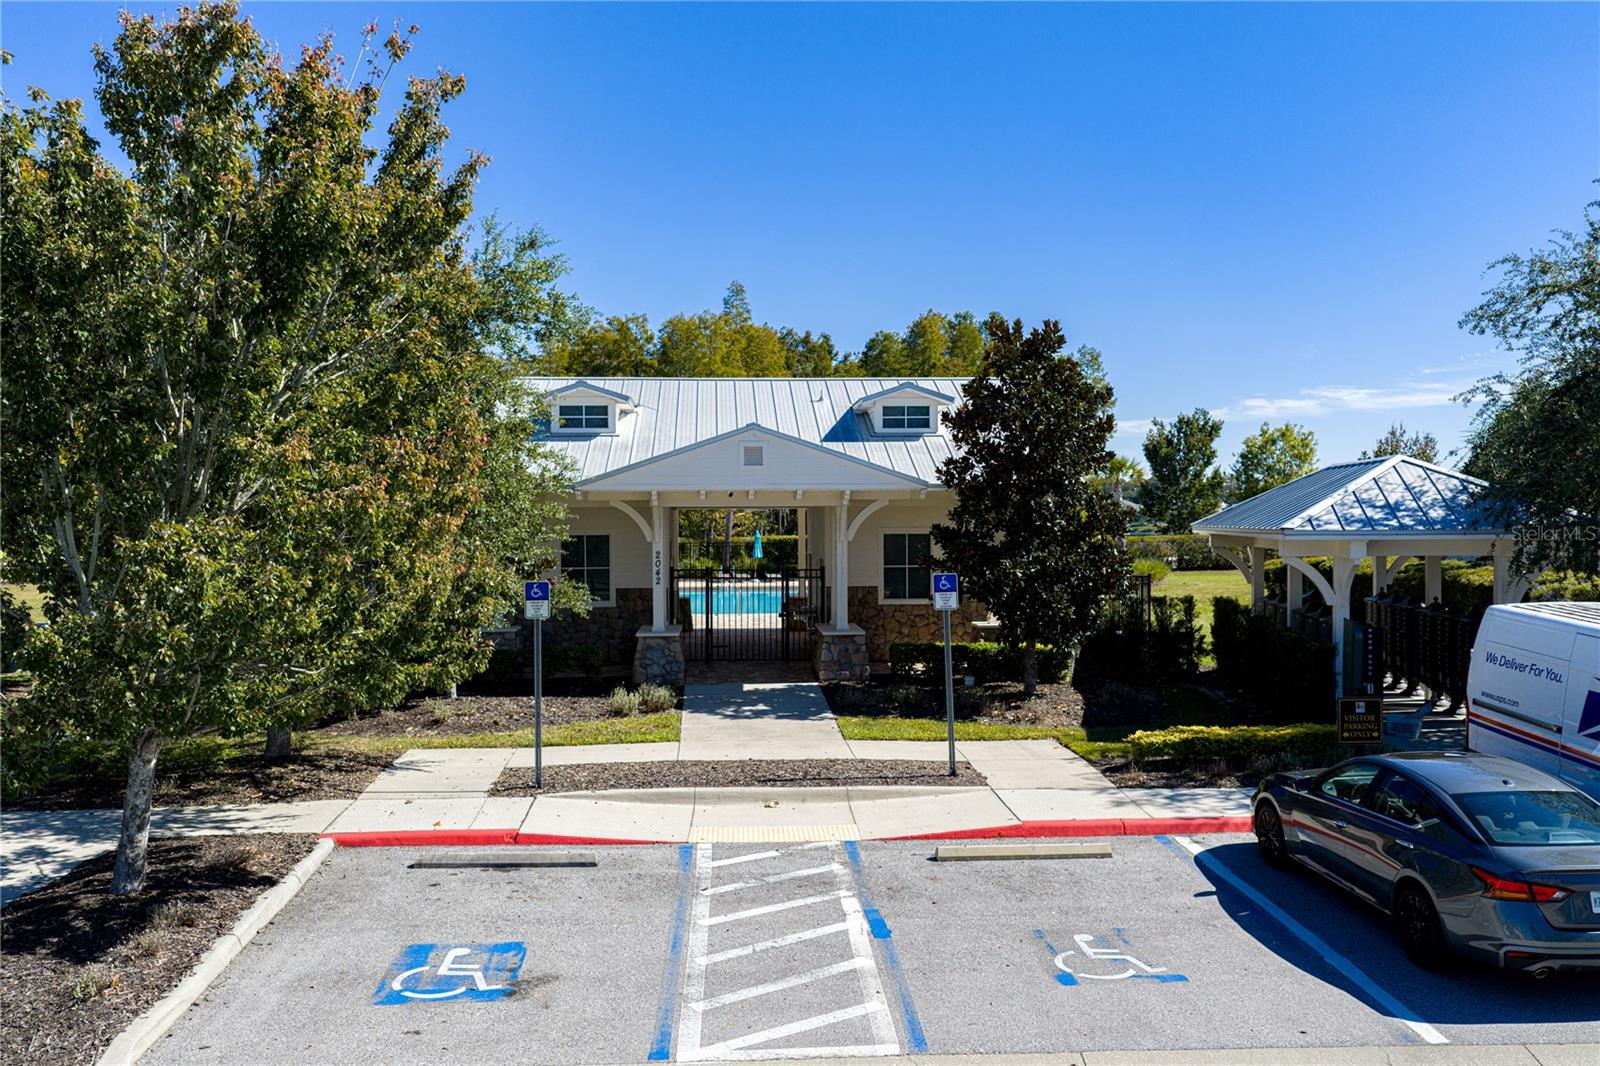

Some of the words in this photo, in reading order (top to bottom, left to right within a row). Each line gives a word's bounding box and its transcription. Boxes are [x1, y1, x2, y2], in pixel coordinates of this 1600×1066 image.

[1486, 651, 1498, 665] We
[1498, 655, 1529, 673] Deliver
[1528, 663, 1545, 677] For
[1545, 666, 1563, 684] You.
[1480, 690, 1520, 708] www.usps.com
[1343, 722, 1378, 730] PARKING
[1350, 730, 1371, 738] ONLY
